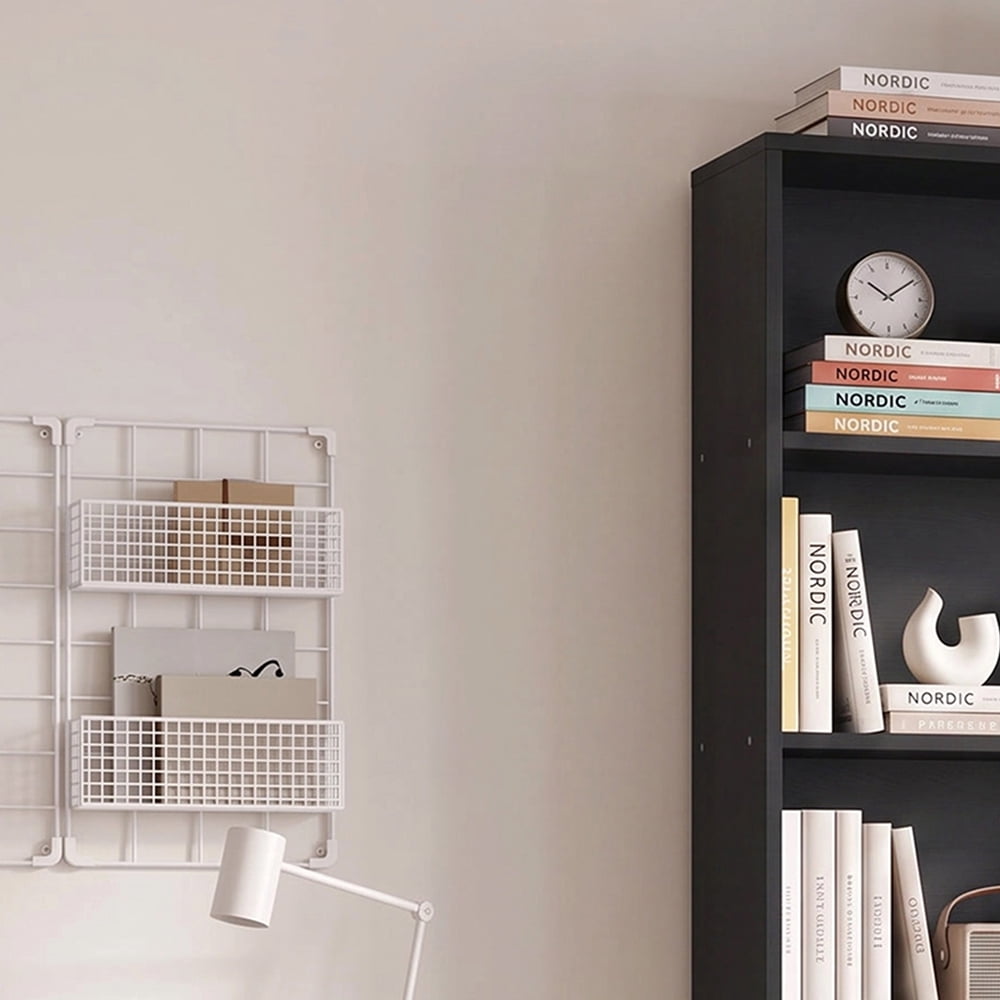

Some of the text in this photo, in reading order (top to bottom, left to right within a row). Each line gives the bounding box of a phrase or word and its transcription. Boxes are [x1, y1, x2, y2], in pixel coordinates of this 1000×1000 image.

[863, 73, 930, 90] NORDIC
[853, 98, 917, 115] NORDIC
[852, 122, 918, 140] NORDIC
[845, 342, 912, 359] NORDIC
[836, 367, 898, 383] NORDIC
[836, 392, 907, 408] NORDIC
[834, 417, 899, 433] NORDIC
[809, 544, 827, 625] NORDIC
[907, 691, 975, 706] NORDIC
